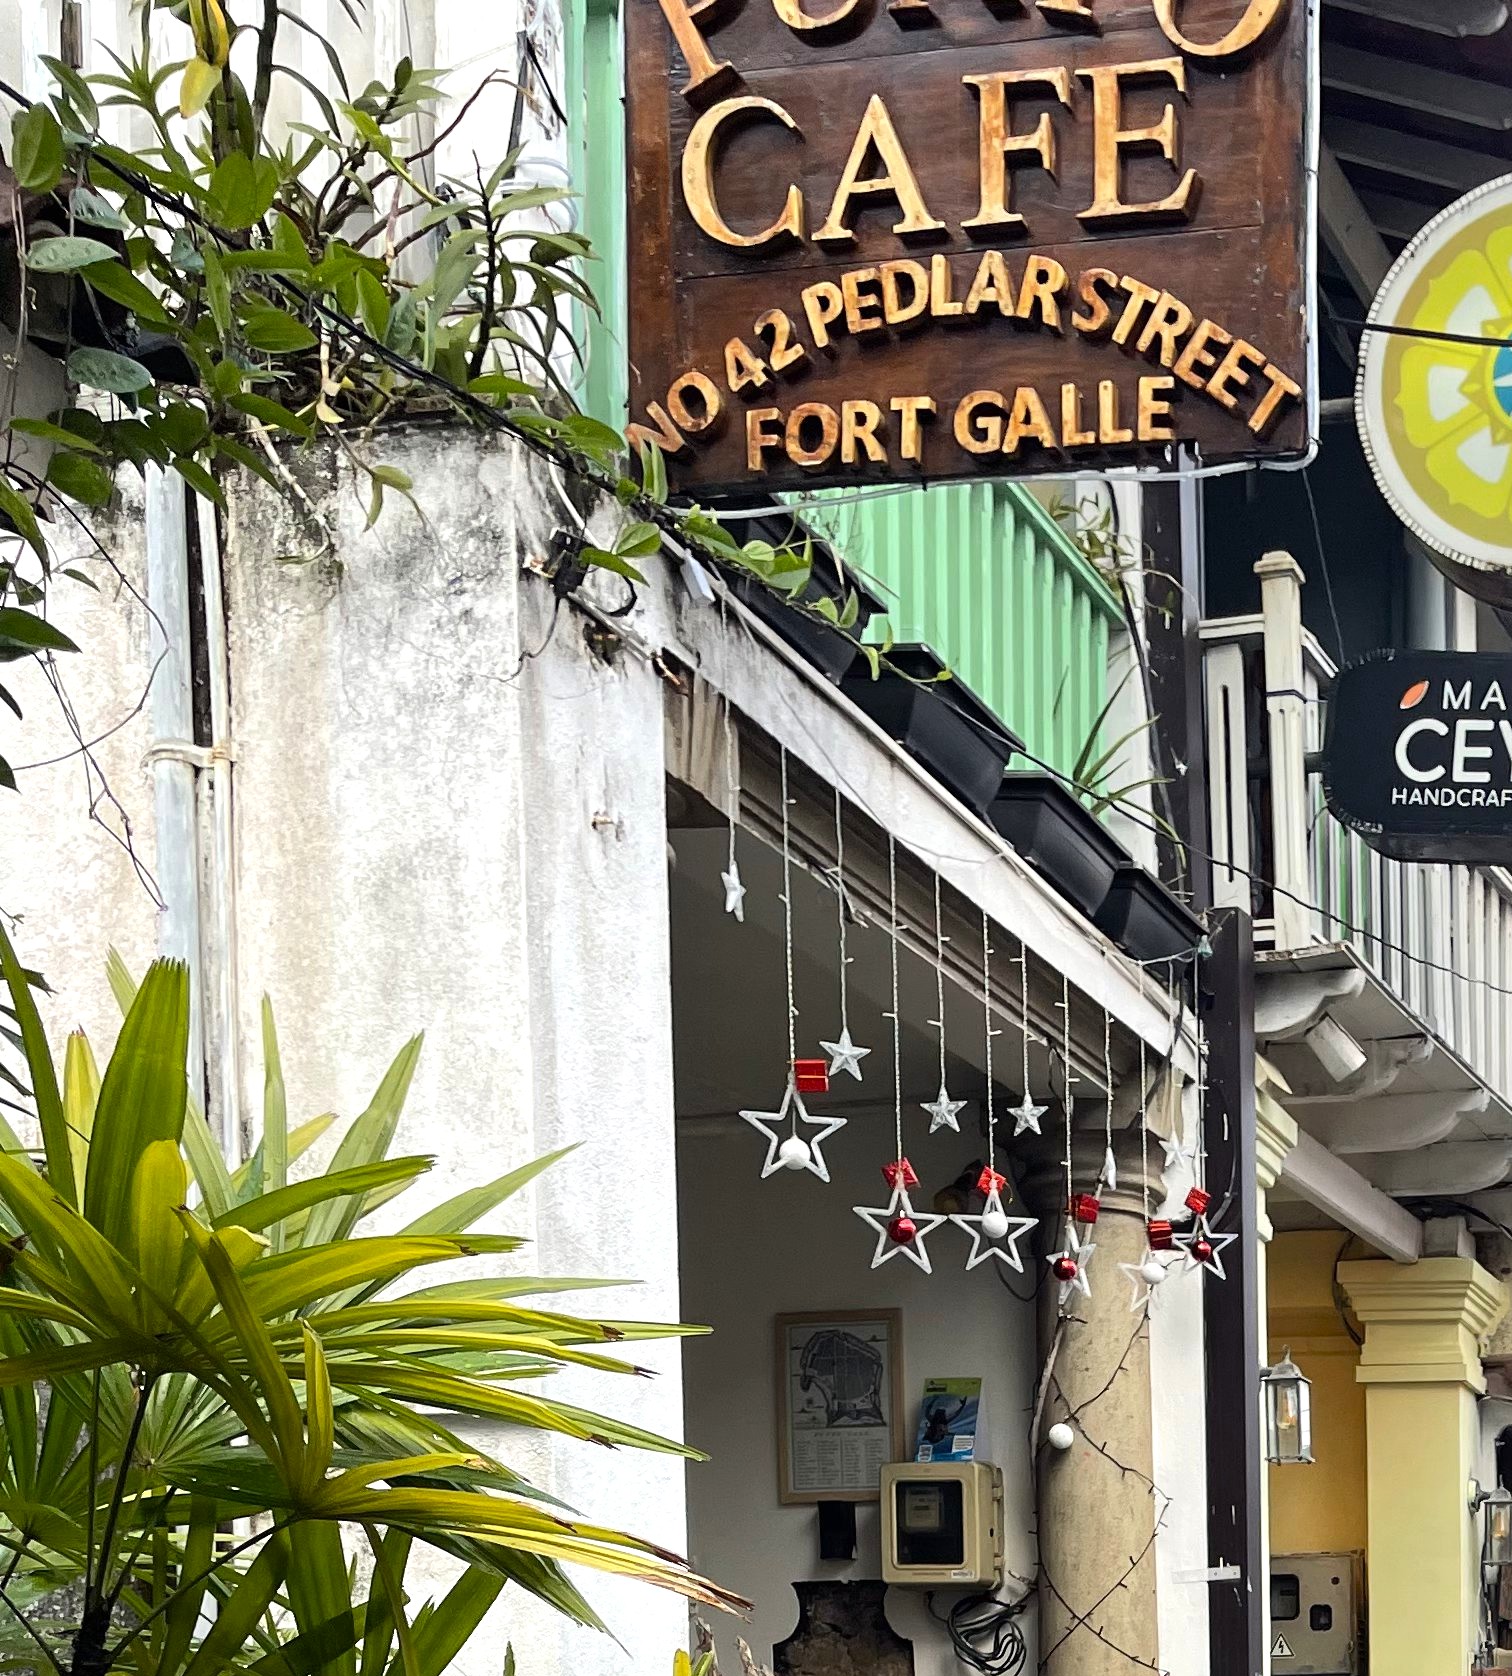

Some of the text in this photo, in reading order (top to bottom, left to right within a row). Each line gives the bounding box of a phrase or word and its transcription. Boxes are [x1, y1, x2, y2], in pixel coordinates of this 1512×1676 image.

[681, 56, 1199, 247] CAFE
[624, 250, 1302, 458] NO 42 PEDLAR STREET
[746, 376, 1176, 472] FORT GALLE
